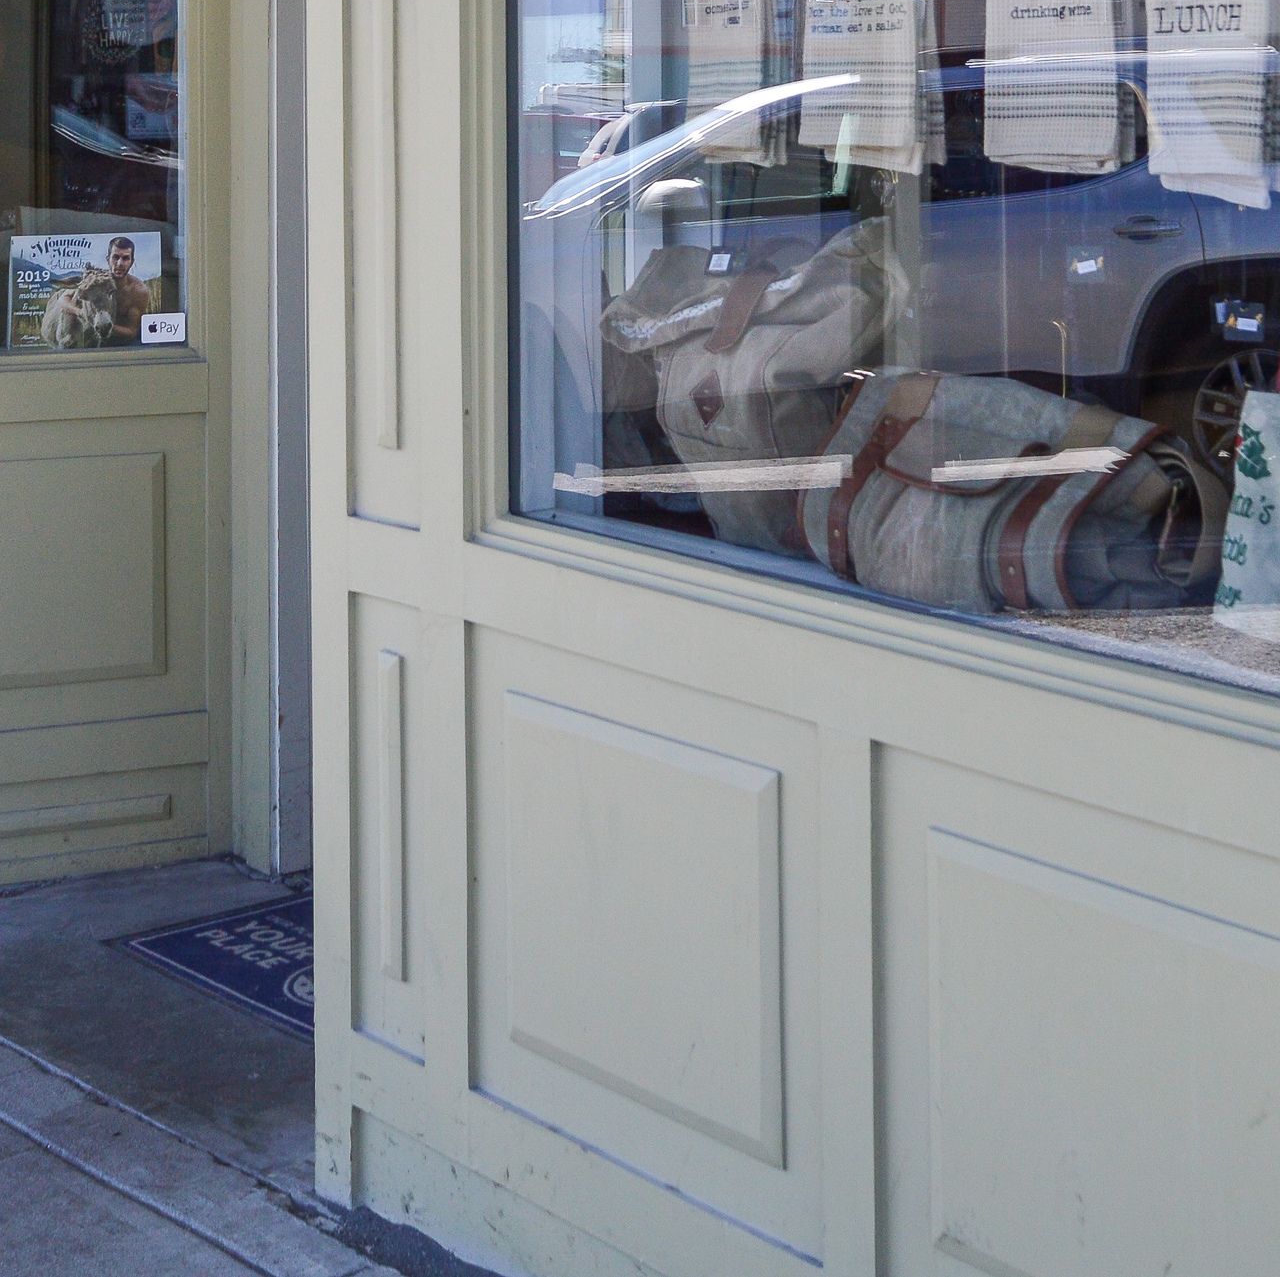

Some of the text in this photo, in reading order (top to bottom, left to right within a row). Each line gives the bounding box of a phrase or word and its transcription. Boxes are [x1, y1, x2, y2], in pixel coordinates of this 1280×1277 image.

[830, 5, 849, 16] the
[853, 5, 873, 16] love
[1011, 6, 1066, 19] drinking
[101, 13, 130, 30] LIVE
[1154, 5, 1242, 33] LUNCH
[811, 24, 843, 34] woman
[848, 23, 863, 32] eat
[99, 30, 133, 48] HAPPY
[31, 237, 91, 258] Mountain
[53, 249, 81, 258] Men
[17, 271, 50, 282] 2019
[159, 321, 180, 336] Pay
[234, 920, 314, 960] YOUR
[195, 928, 291, 970] PLACE
